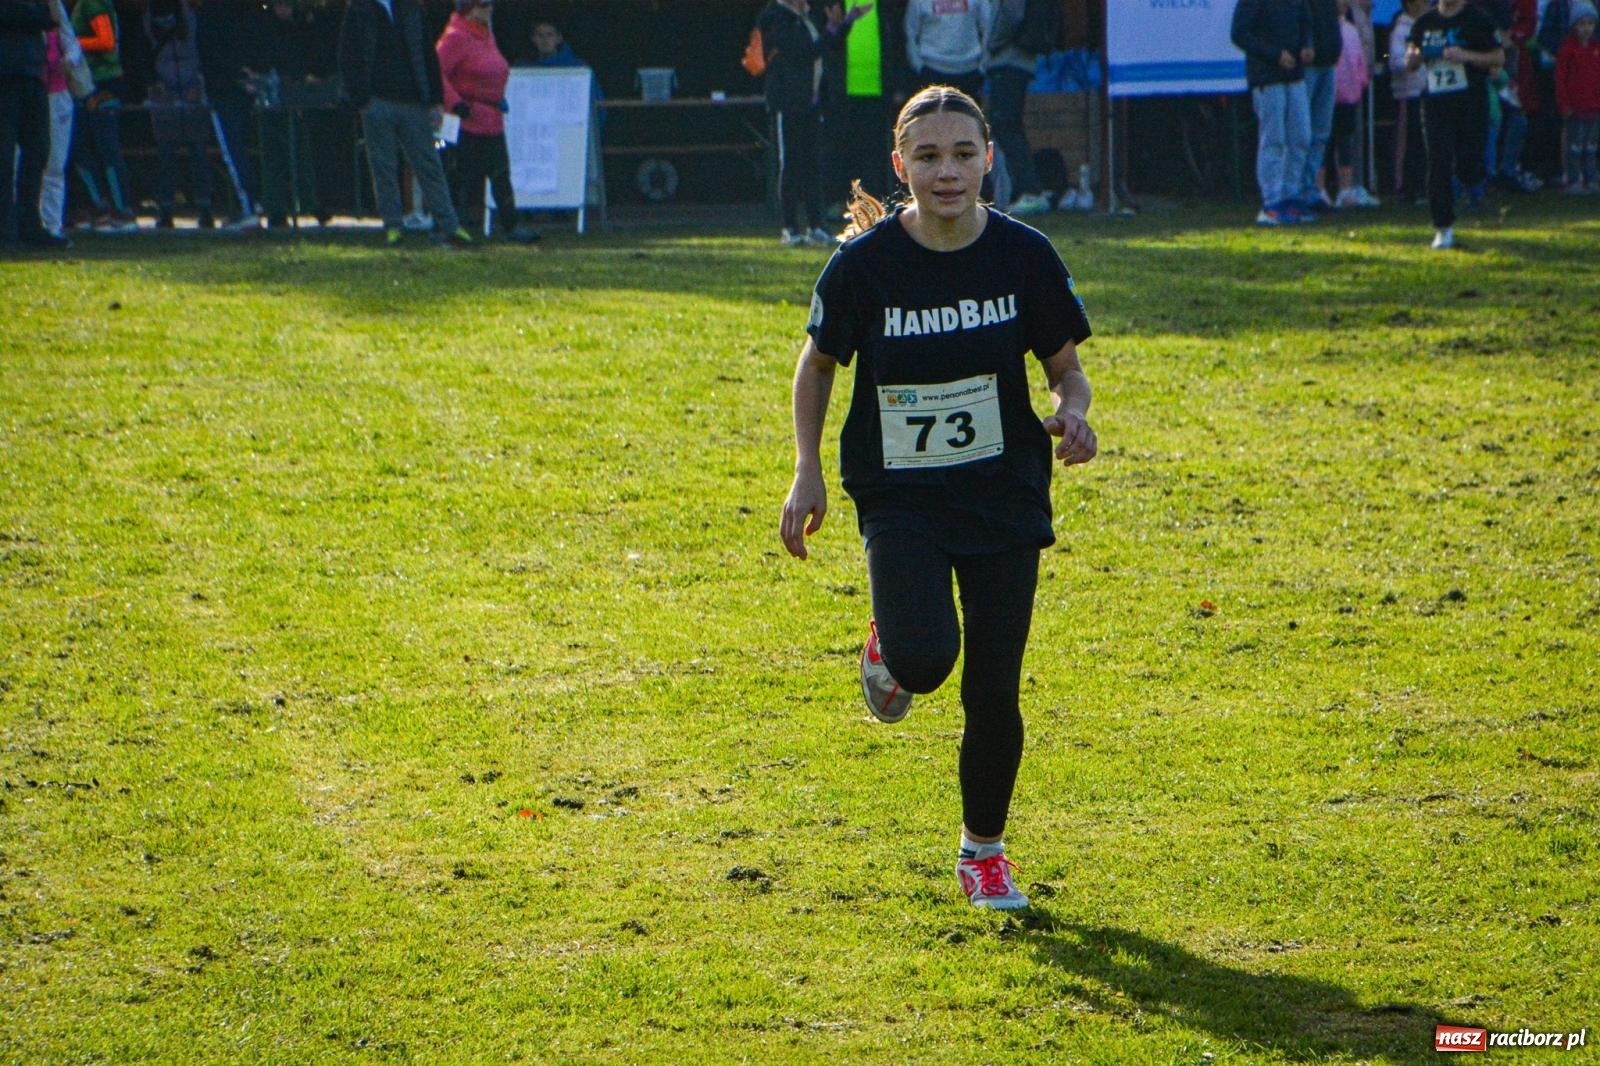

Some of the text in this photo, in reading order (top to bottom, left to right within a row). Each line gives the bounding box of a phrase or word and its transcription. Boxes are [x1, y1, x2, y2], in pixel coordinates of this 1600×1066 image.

[1434, 68, 1457, 86] 72
[922, 384, 990, 401] www.personalbest.pl
[906, 410, 976, 452] 73
